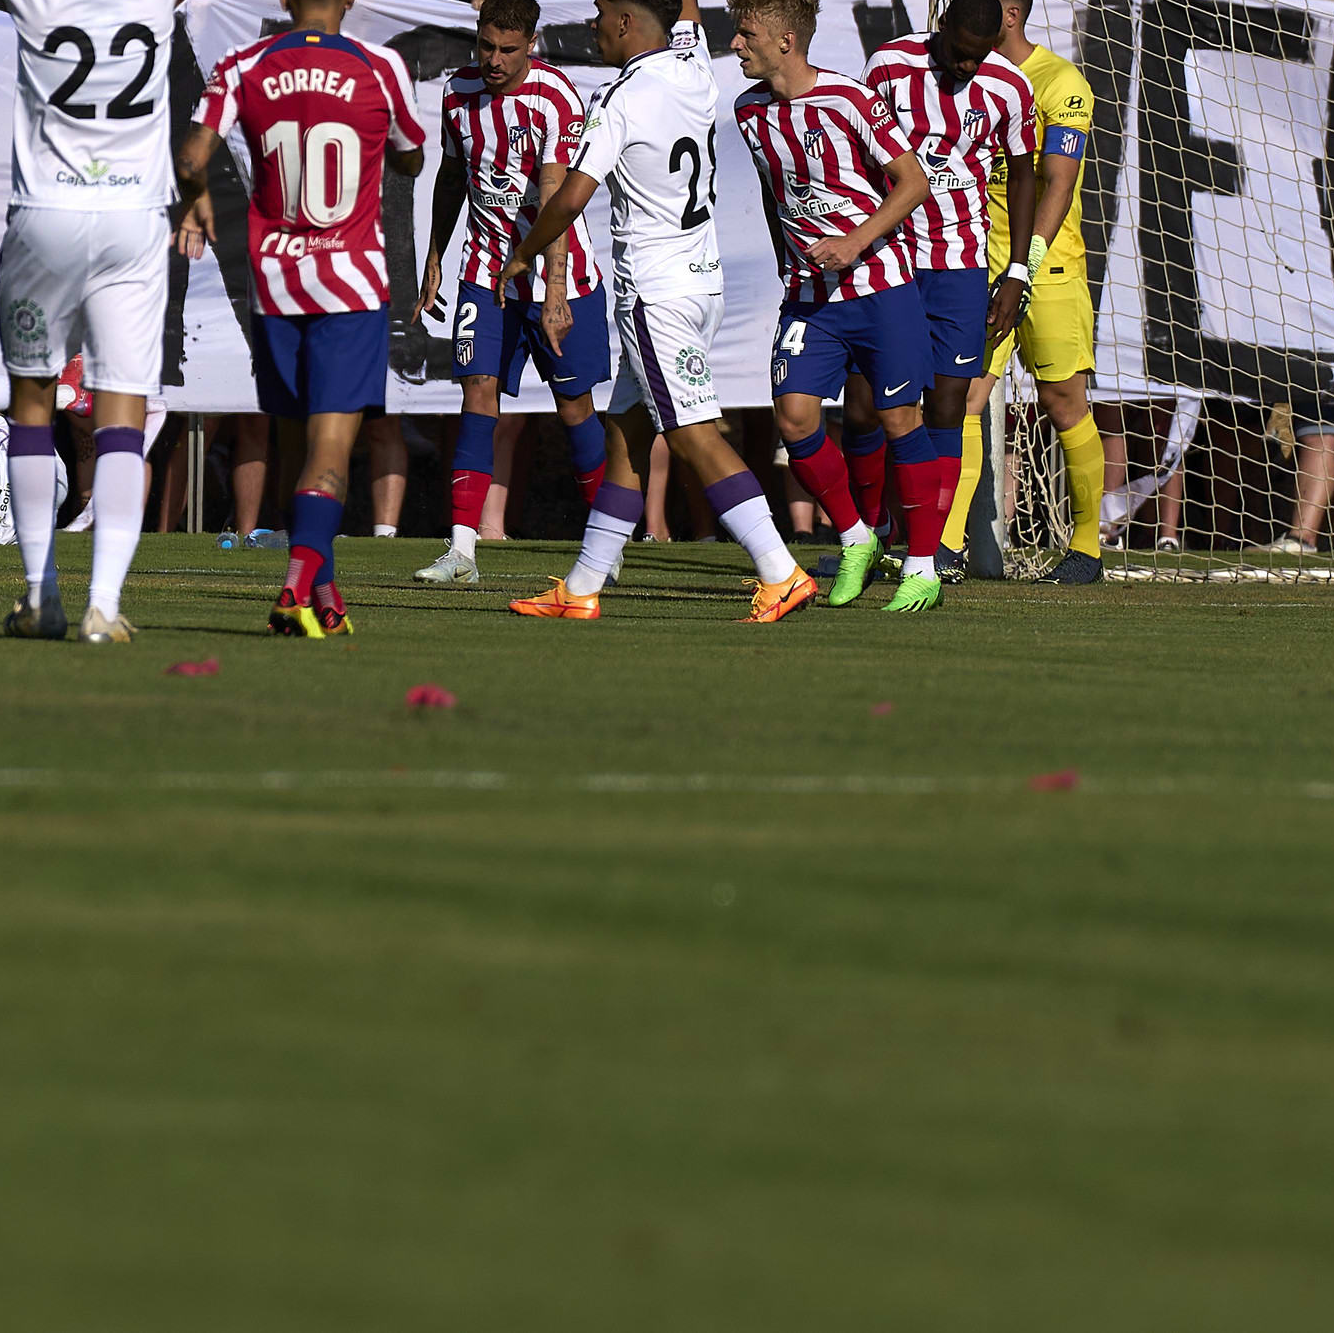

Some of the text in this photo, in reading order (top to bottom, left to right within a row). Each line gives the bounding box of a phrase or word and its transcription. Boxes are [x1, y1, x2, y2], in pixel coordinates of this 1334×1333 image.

[43, 22, 158, 120] 22
[262, 68, 356, 102] CORREA
[871, 114, 893, 131] HYUN
[260, 120, 361, 228] 10
[928, 174, 977, 188] eFin.com
[472, 190, 540, 208] WhaleFin.co
[780, 196, 852, 218] haleFin.com
[259, 231, 307, 258] ria
[456, 301, 478, 339] 2
